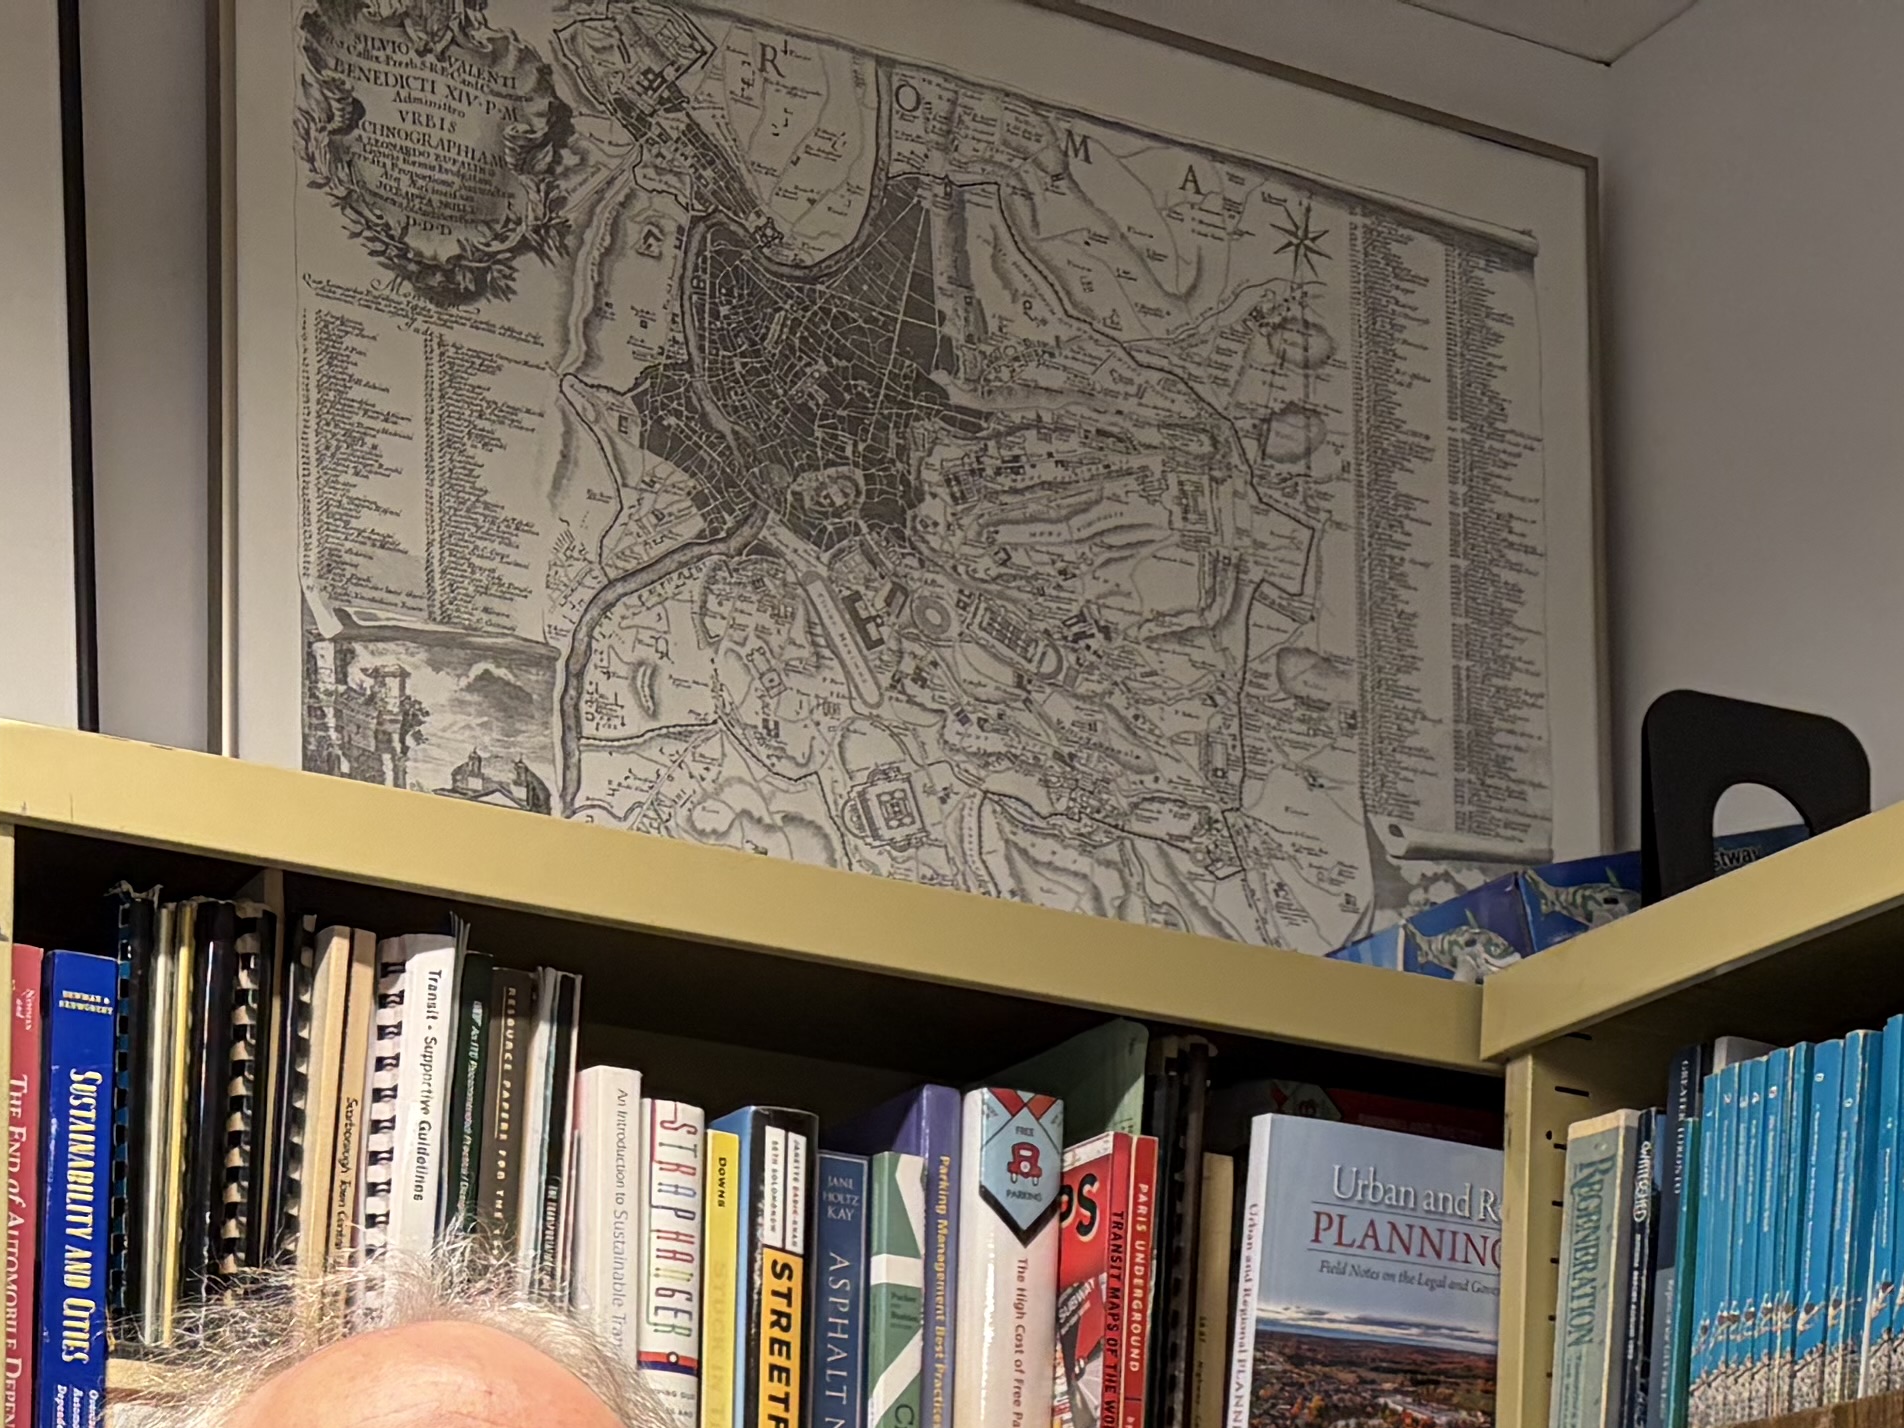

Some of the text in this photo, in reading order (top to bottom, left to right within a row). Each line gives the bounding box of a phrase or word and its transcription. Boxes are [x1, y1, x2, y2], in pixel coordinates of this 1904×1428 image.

[1332, 1164, 1471, 1219] Urban and
[826, 1251, 850, 1403] ASPHALT
[1128, 1183, 1149, 1373] PARIS UNDERGROUND
